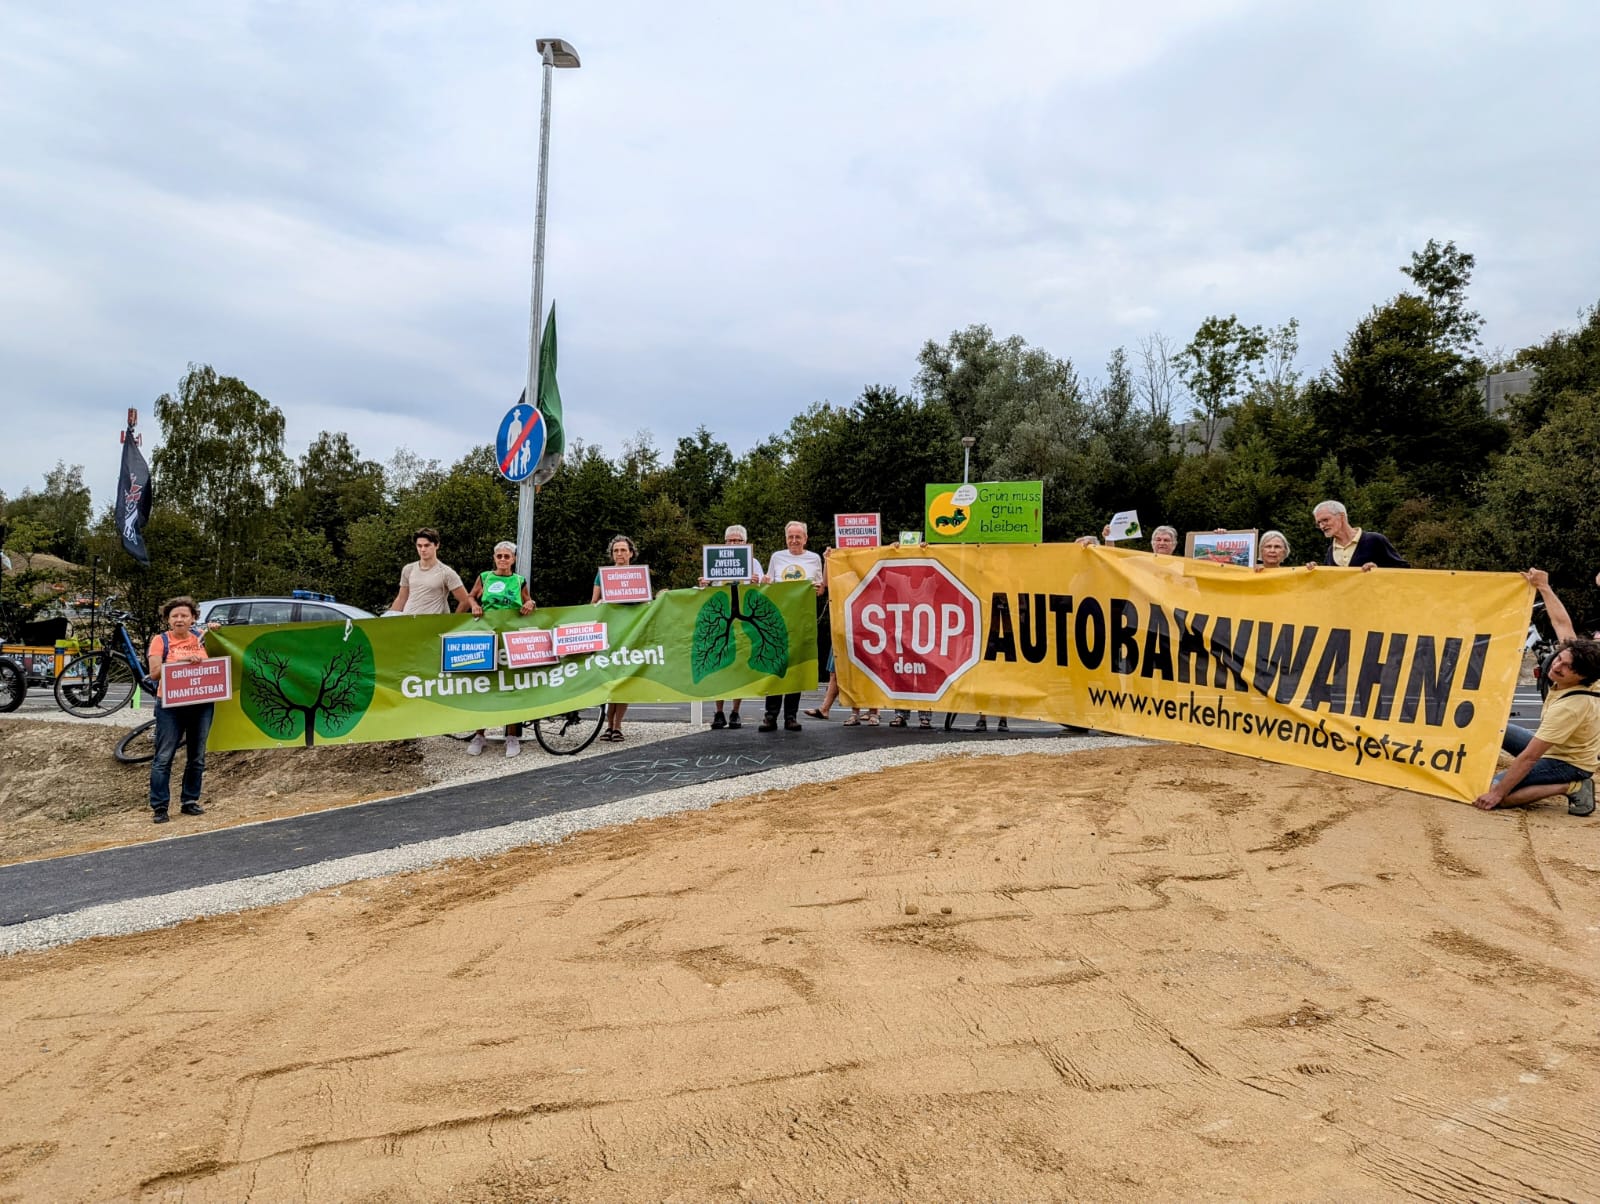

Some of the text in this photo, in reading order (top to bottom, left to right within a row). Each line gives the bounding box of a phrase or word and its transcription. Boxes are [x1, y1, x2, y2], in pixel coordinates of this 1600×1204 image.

[979, 488, 1009, 503] Grün
[1013, 491, 1040, 502] muss
[991, 503, 1023, 517] grün
[844, 517, 869, 525] ENDLICH
[980, 519, 1028, 533] bleiben
[838, 526, 877, 536] VERSIEGELUNG
[845, 537, 870, 546] STOPPEN
[718, 549, 735, 558] KEIN
[714, 558, 740, 567] ZWEITES
[710, 567, 746, 577] OHLSDORF
[605, 587, 647, 597] UNANTASTBAR
[565, 627, 594, 635] ENDLICH
[860, 603, 966, 656] STOP
[557, 633, 603, 644] VERSIEGELUNG
[447, 642, 490, 652] LINZ BRAUCHT
[526, 643, 535, 651] IST
[565, 643, 594, 653] STOPPEN
[450, 652, 485, 663] FRISCHLUFT
[984, 592, 1491, 728] AUTOBAHNWAHN!
[893, 656, 927, 675] dem
[171, 665, 220, 679] GRÜNGÜRTEL
[401, 645, 665, 698] Grüne Lunge retten!
[190, 677, 201, 686] IST
[167, 683, 224, 699] UNANTASTBAR
[1088, 687, 1467, 774] www.verkehrswende-jetzt.at
[610, 754, 772, 770] GRÜN
